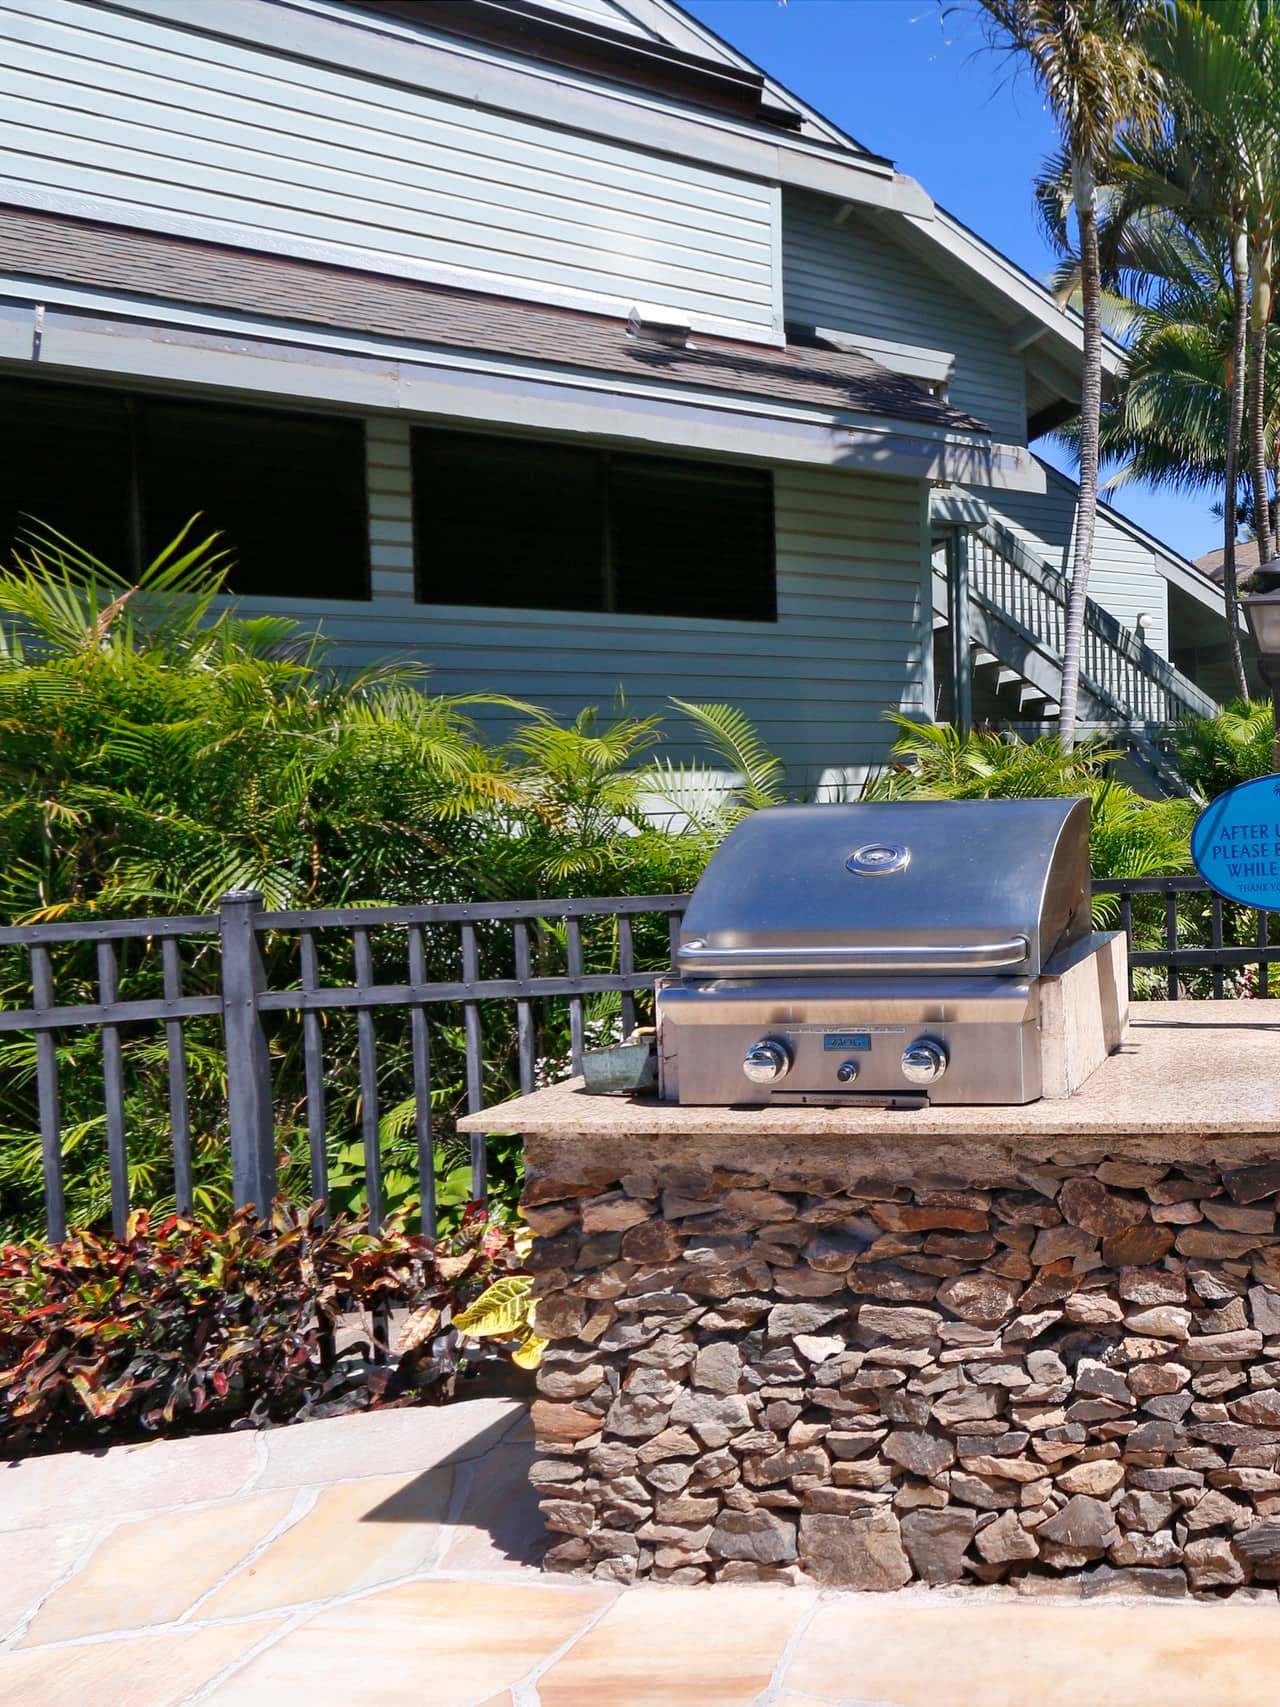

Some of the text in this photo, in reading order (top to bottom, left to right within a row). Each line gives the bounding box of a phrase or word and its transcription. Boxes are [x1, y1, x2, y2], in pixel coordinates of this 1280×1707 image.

[1220, 824, 1269, 841] AFTER
[1213, 843, 1268, 860] PLEASE
[1228, 862, 1278, 877] WHILE
[1239, 884, 1267, 893] THANK
